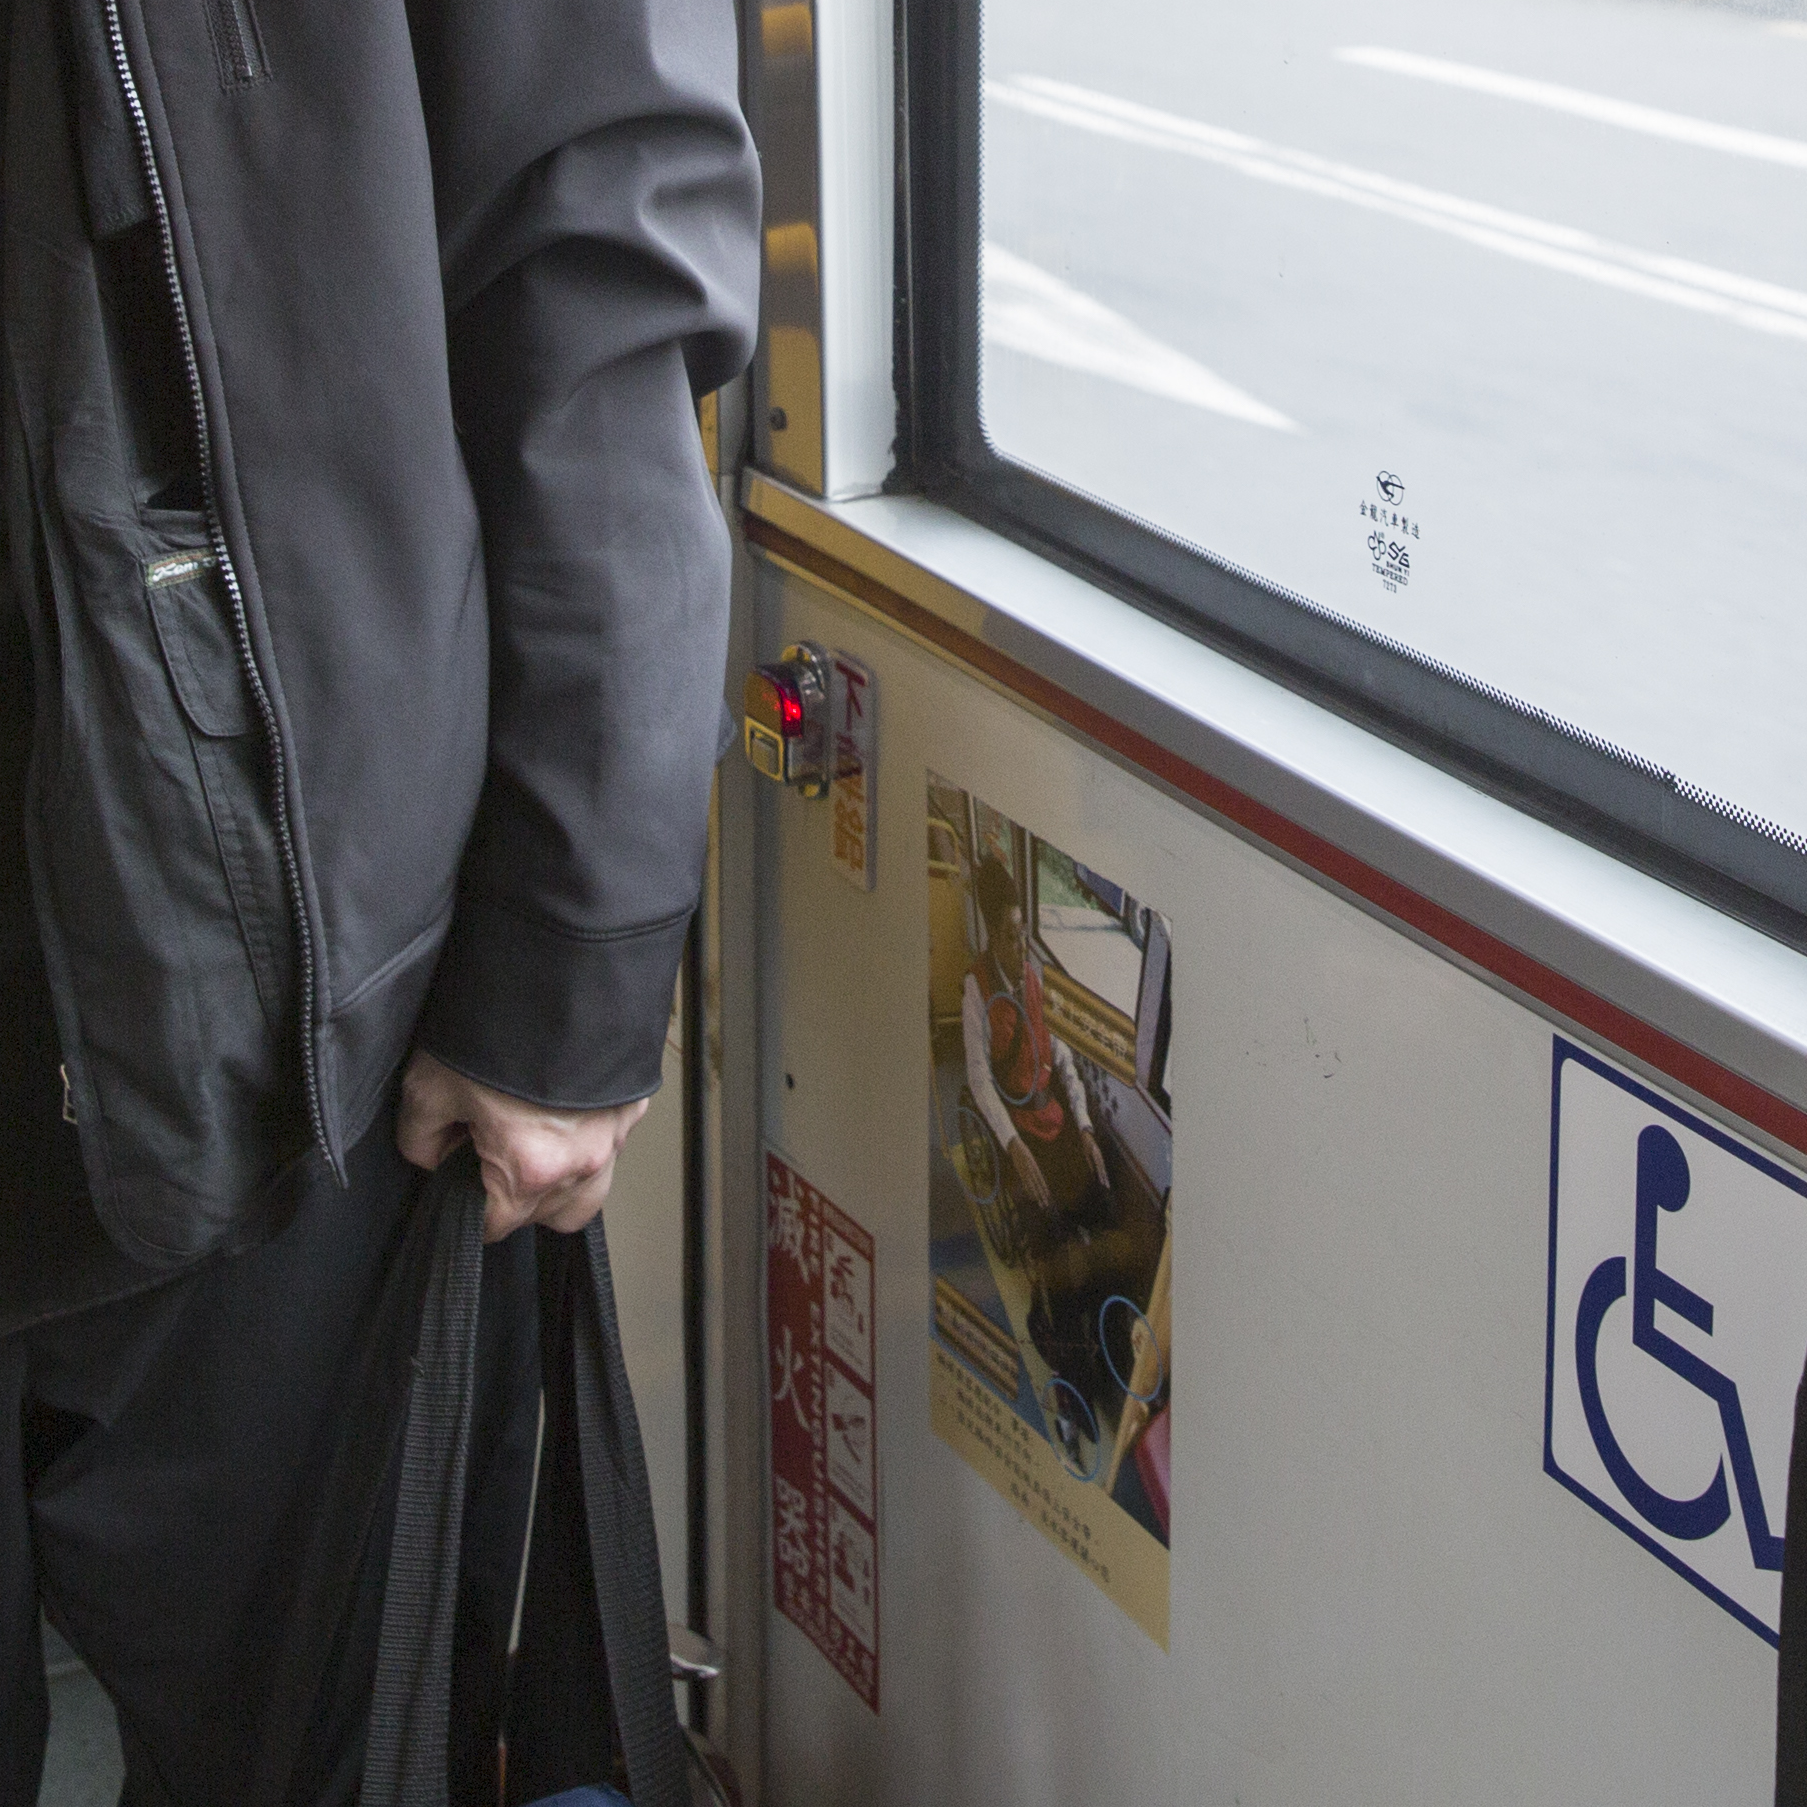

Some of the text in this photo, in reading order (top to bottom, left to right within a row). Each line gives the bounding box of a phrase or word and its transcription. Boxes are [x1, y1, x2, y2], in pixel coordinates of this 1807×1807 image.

[1359, 500, 1421, 540] 金龍汽車製造
[1372, 563, 1409, 586] TEMPERED
